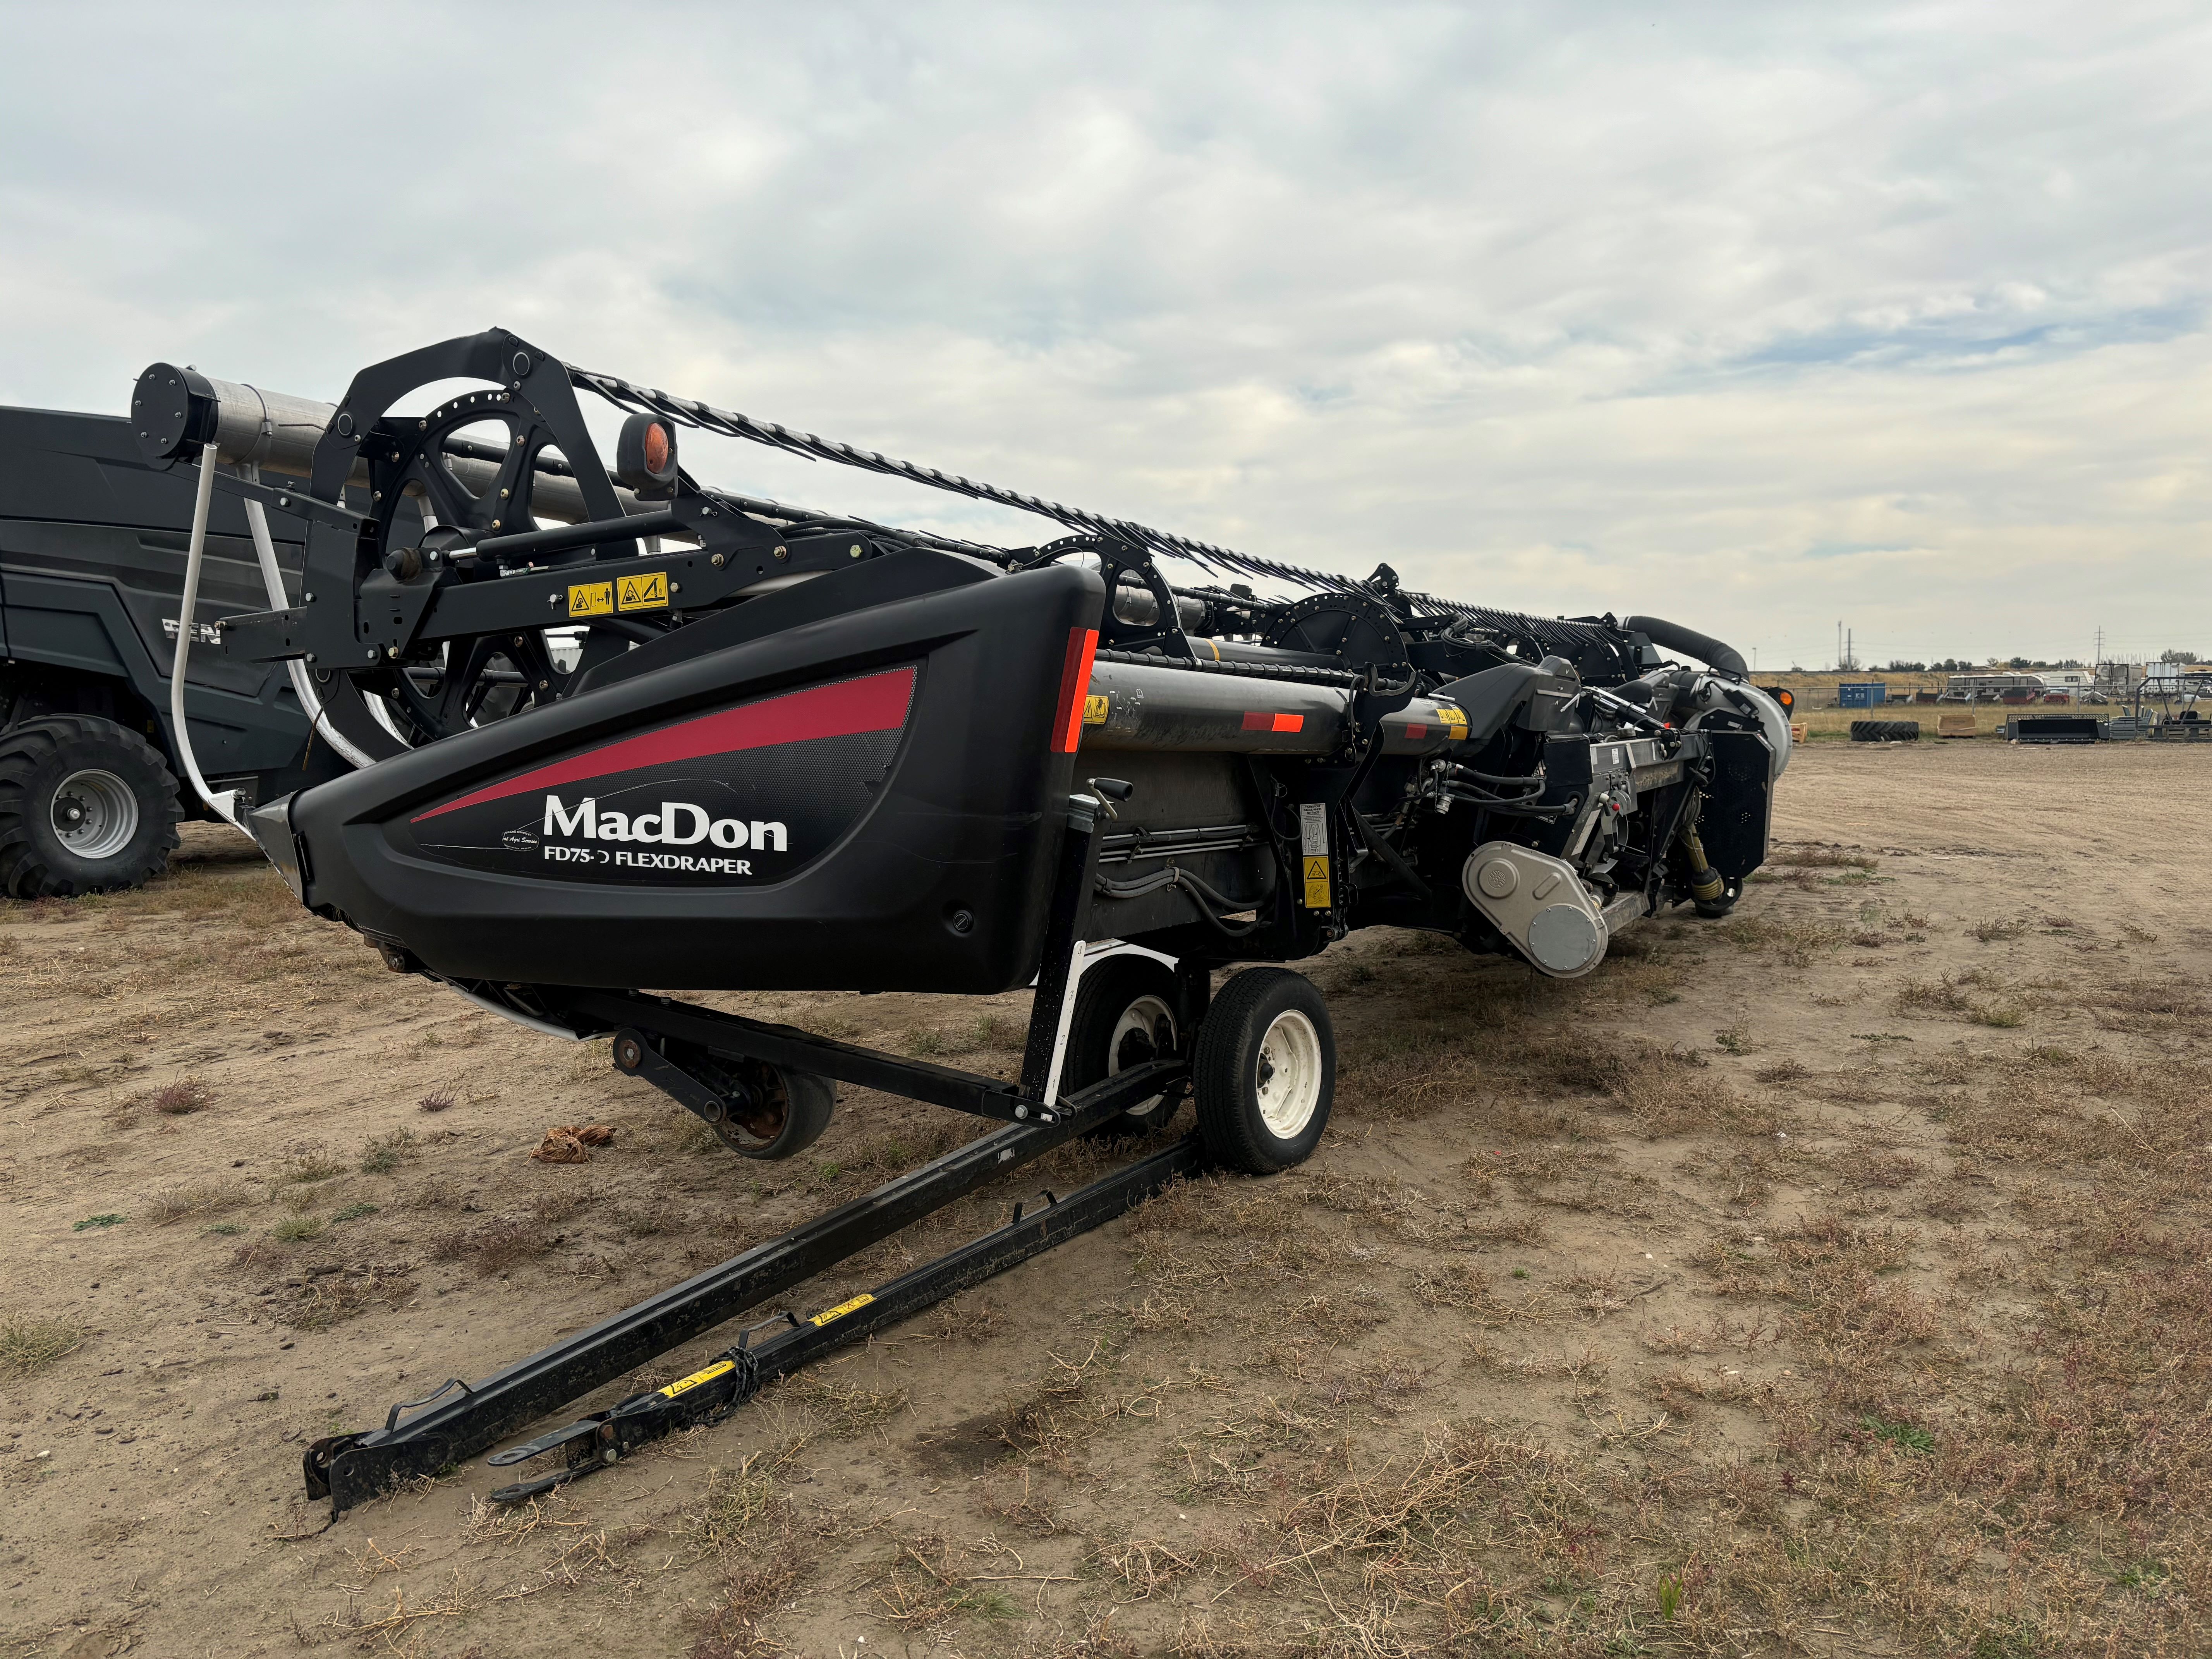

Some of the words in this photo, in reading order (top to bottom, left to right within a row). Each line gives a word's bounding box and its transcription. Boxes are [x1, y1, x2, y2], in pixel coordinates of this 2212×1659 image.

[543, 795, 787, 852] MacDon
[616, 851, 752, 875] FLEXDRAPER
[1060, 1035, 1065, 1045] 2
